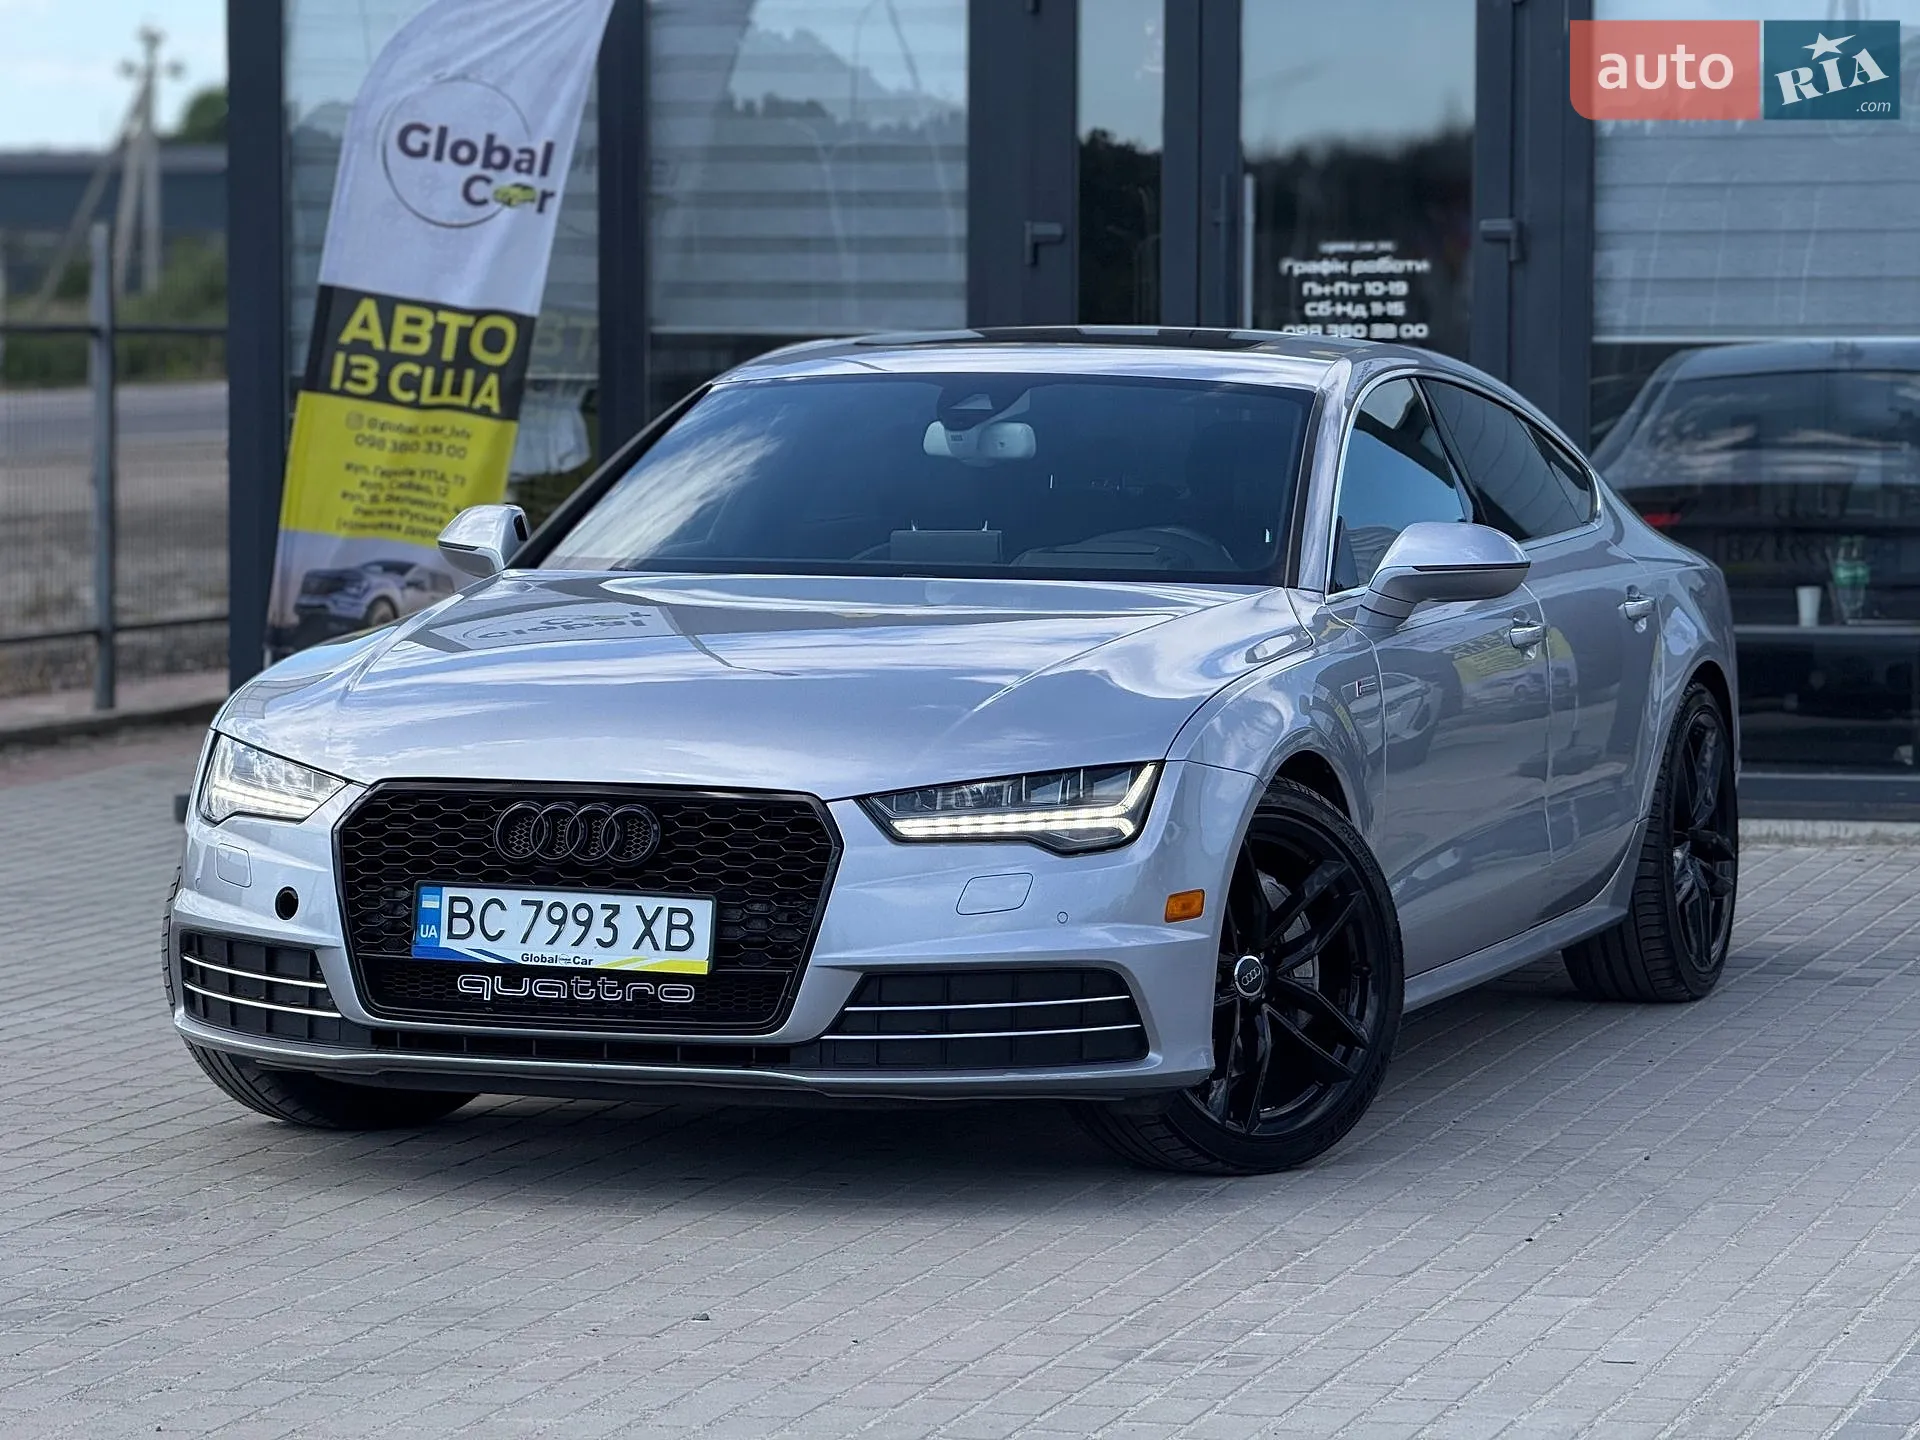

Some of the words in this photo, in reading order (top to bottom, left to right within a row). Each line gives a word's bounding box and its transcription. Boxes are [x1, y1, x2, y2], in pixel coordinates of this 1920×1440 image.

[397, 123, 555, 177] Global
[463, 174, 555, 214] Cr
[338, 297, 517, 366] АВТО
[330, 351, 379, 395] ІЗ
[388, 361, 501, 414] США
[419, 924, 439, 939] UA
[446, 896, 508, 942] BC
[519, 899, 622, 949] 7993
[631, 904, 695, 952] XB
[520, 952, 558, 964] Global
[572, 956, 594, 966] Car
[457, 974, 695, 1003] quattro
